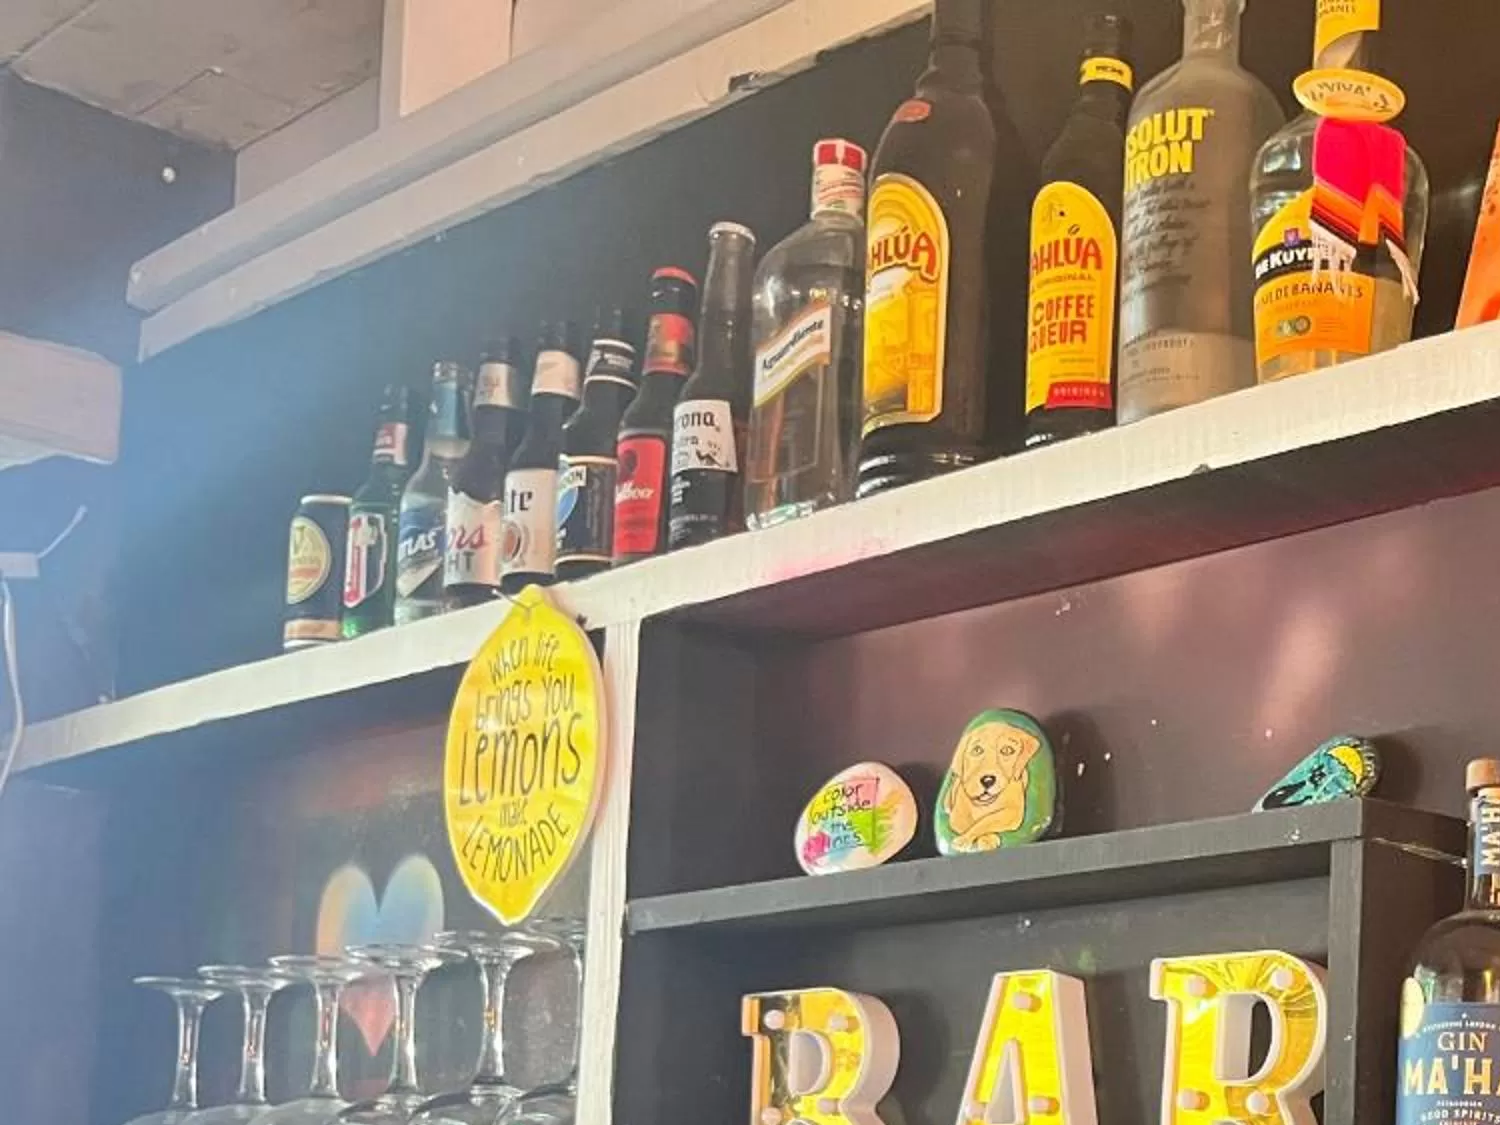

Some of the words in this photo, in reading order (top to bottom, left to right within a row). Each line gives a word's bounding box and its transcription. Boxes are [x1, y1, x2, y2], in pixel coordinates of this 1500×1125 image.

[1032, 294, 1095, 327] COFFEE
[462, 801, 571, 883] LEMONADE
[1437, 1031, 1489, 1053] GIN
